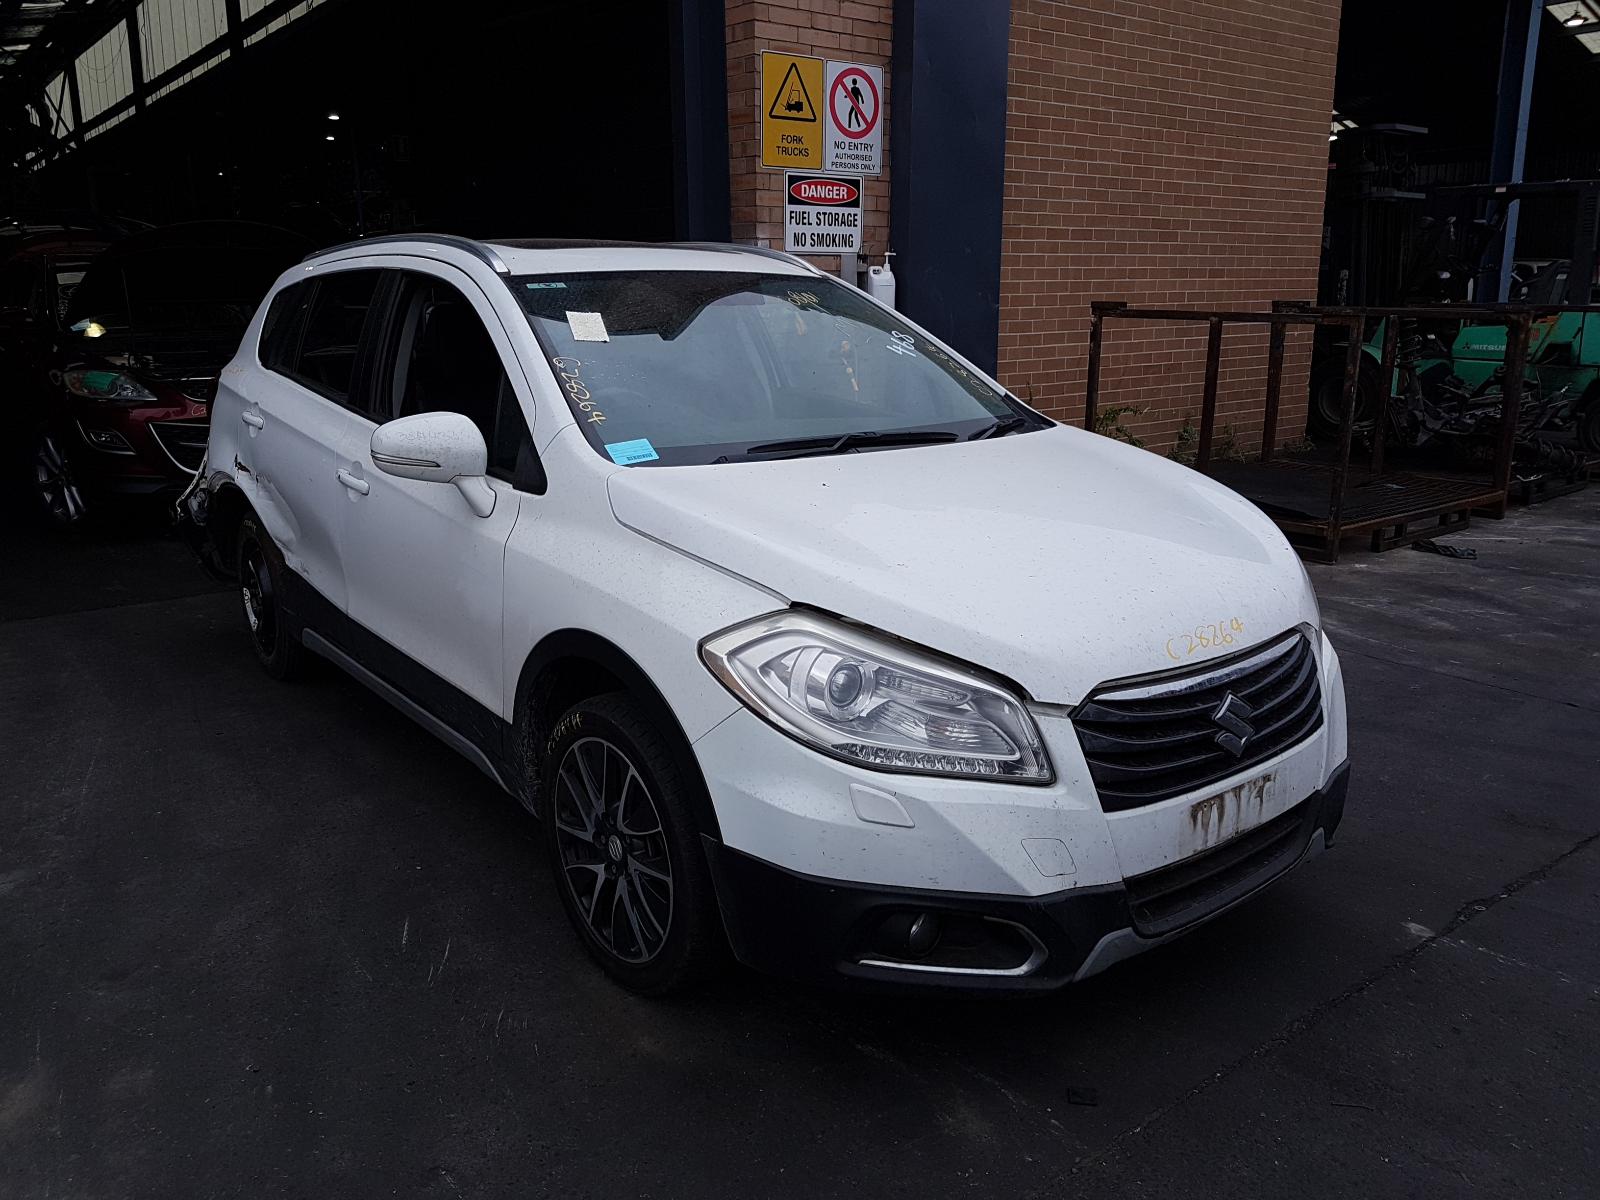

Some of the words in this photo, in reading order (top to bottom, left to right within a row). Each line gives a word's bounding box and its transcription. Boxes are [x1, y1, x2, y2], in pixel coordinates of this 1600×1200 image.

[781, 134, 804, 145] FORK
[775, 145, 810, 158] TRUCKS
[833, 141, 847, 150] NO
[848, 142, 874, 152] ENTRY
[834, 152, 873, 162] AUTHORISED
[831, 161, 855, 170] PERSONS
[855, 162, 876, 171] ONLY
[801, 183, 848, 200] DANGER
[789, 210, 813, 226] FUEL
[815, 211, 858, 228] STORAGE
[793, 231, 807, 247] NO
[809, 232, 854, 249] SMOKING
